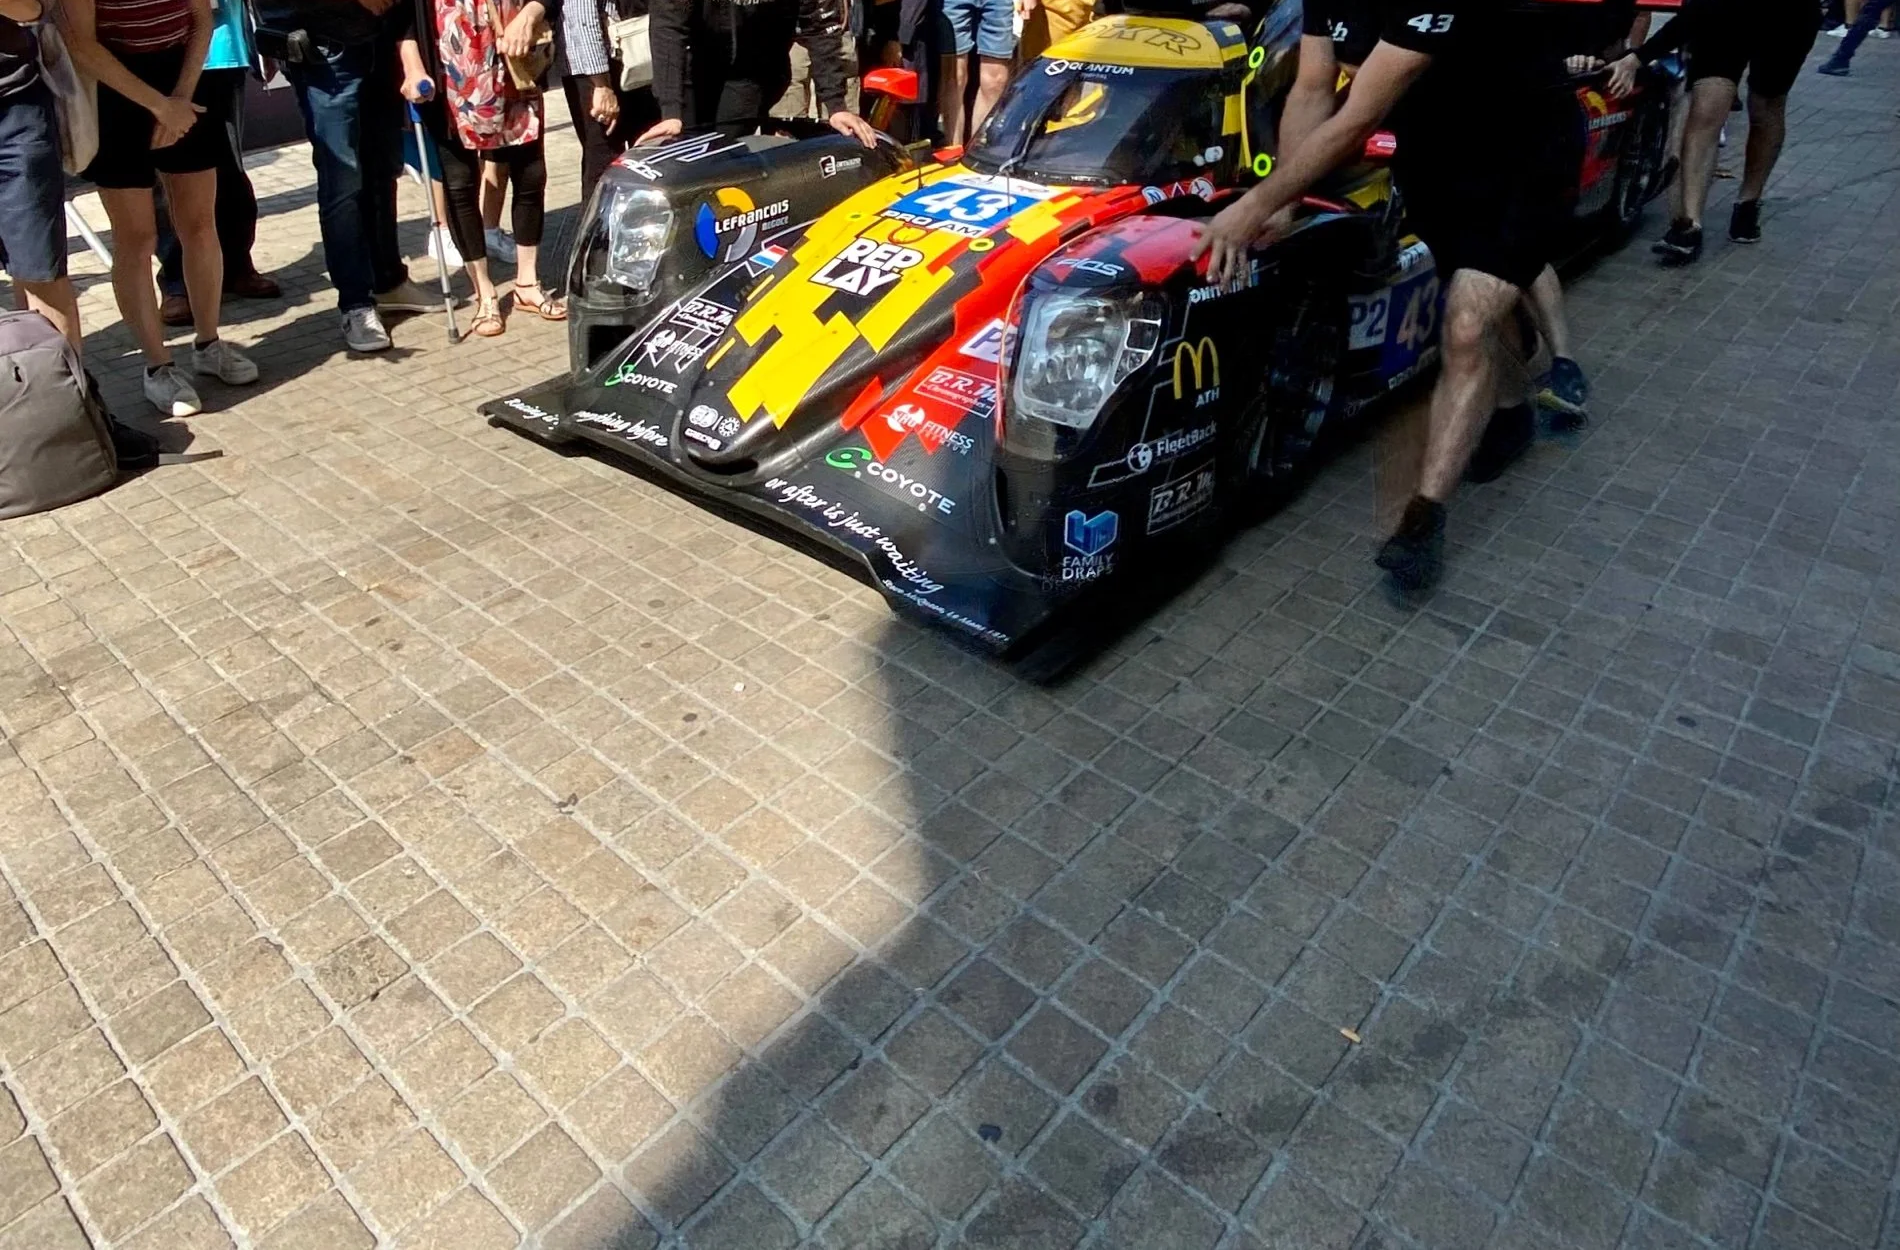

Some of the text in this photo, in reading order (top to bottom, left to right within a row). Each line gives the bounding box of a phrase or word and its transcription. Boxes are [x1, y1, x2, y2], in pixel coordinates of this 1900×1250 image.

[1407, 13, 1455, 33] 43
[914, 188, 1017, 221] 43
[880, 209, 984, 236] PRO AM
[836, 238, 923, 272] REP
[809, 258, 902, 295] LAY
[1350, 297, 1387, 338] P2
[1396, 276, 1440, 350] 43
[625, 372, 678, 394] COYOTE
[627, 420, 669, 447] before
[923, 421, 975, 449] FITNESS
[1156, 420, 1218, 457] FleetBack
[866, 462, 956, 515] COYOTE
[765, 478, 945, 594] or after is just waiting
[1062, 554, 1115, 568] FAMILY
